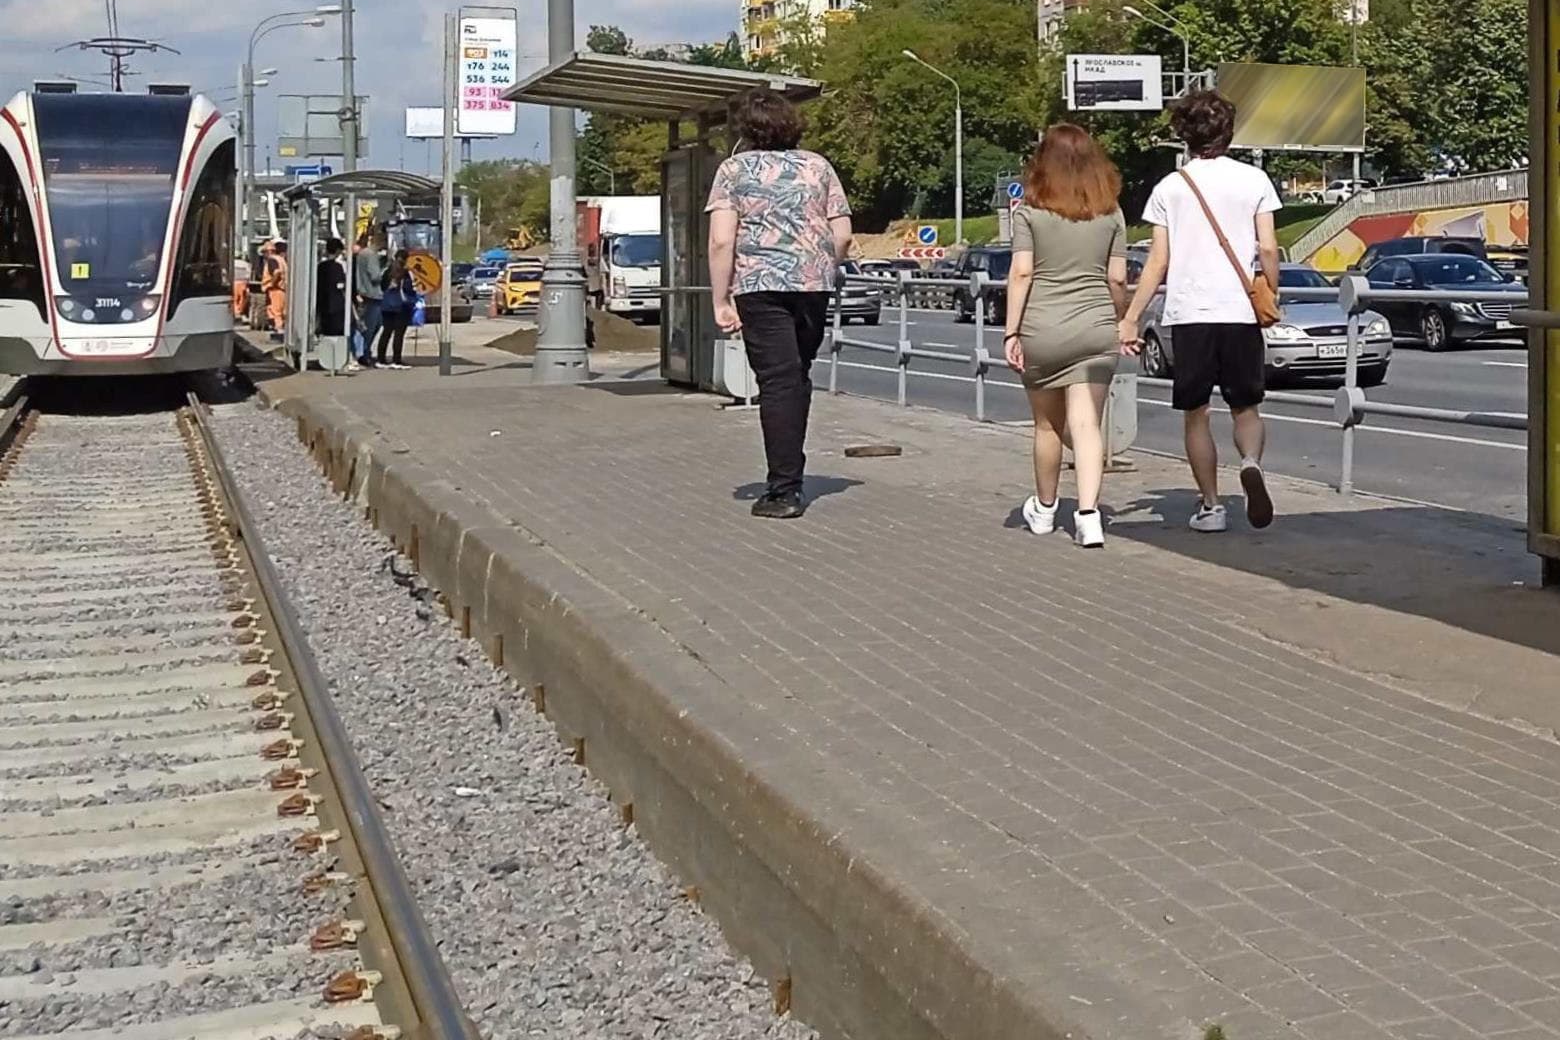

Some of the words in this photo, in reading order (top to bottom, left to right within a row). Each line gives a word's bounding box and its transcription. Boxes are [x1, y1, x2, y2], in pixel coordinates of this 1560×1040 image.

[492, 63, 510, 71] 244
[469, 88, 481, 96] 93
[466, 101, 484, 109] 375
